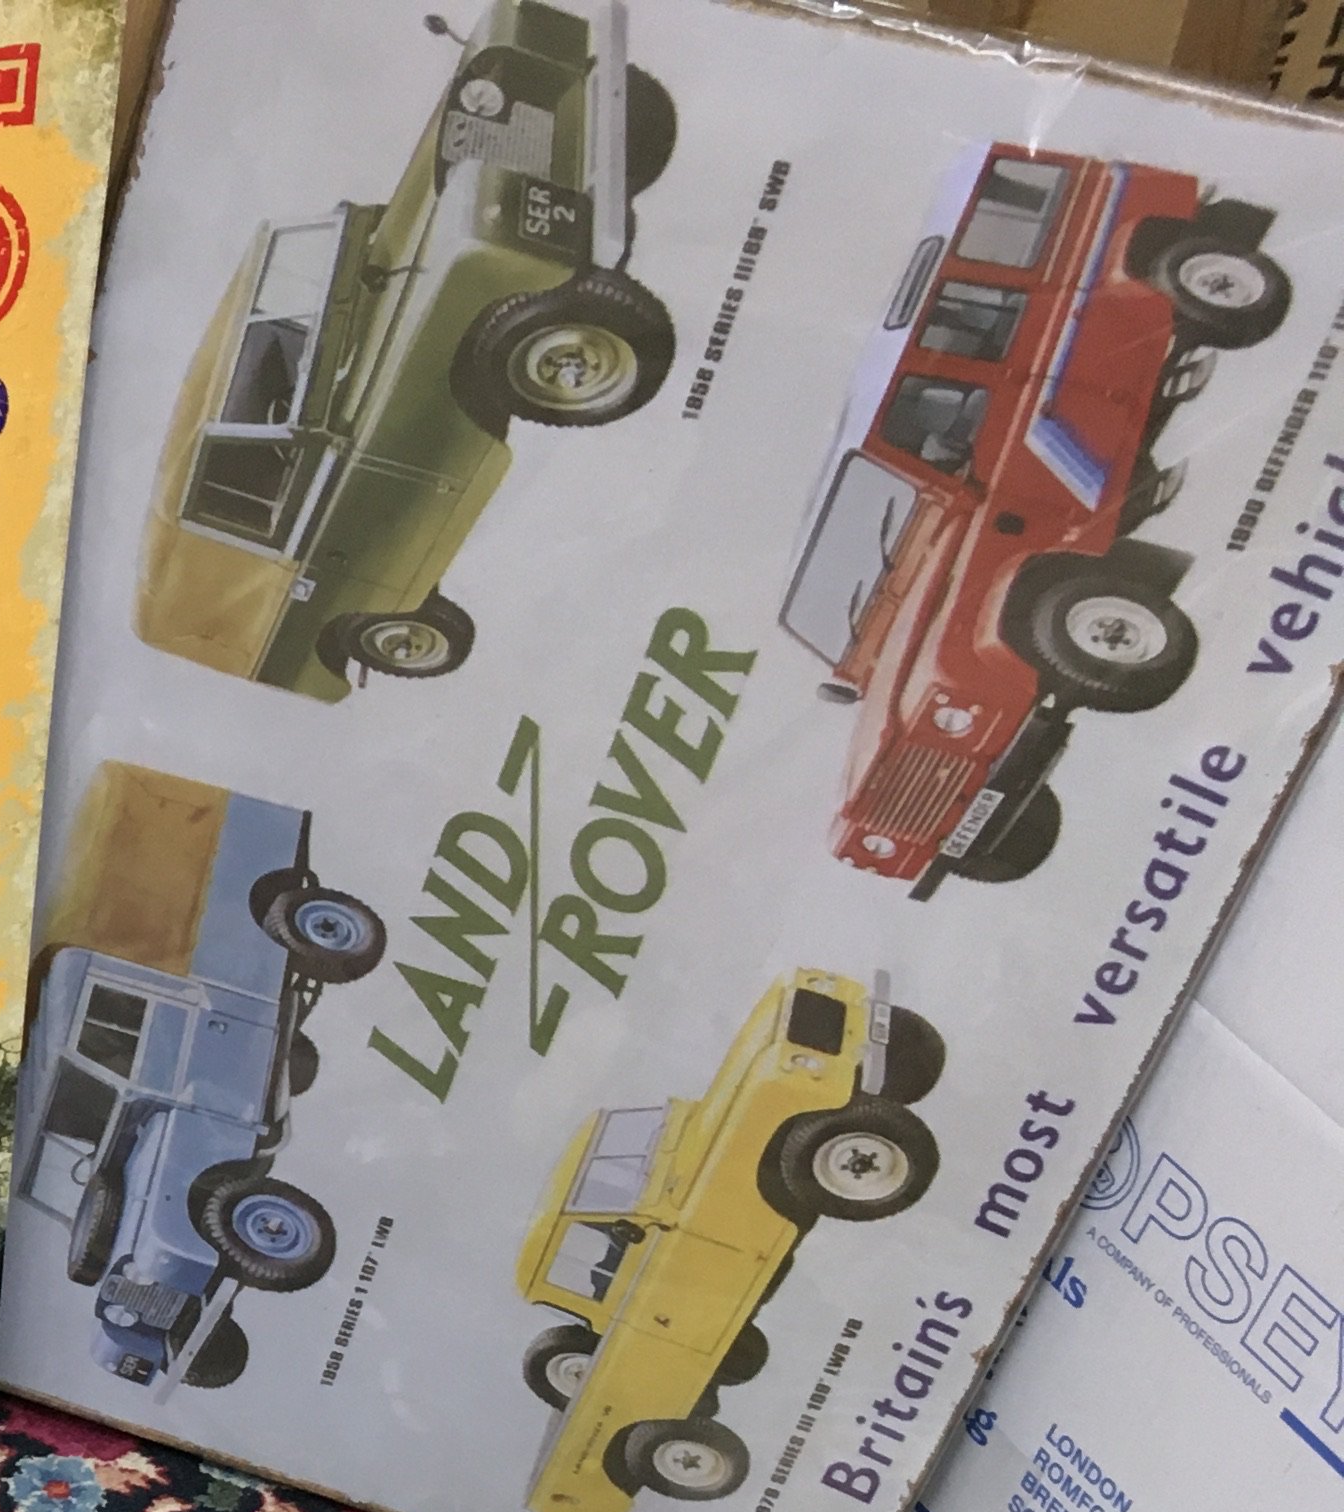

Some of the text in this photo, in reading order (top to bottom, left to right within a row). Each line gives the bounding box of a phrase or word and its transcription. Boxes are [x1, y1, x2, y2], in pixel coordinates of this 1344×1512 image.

[525, 186, 551, 236] SER
[553, 206, 575, 223] 2
[703, 286, 744, 364] SERIES
[367, 606, 759, 1105] LAND ROVER
[820, 1290, 974, 1505] Britain's
[974, 1088, 1078, 1241] most
[1072, 744, 1248, 1025] versatile
[334, 1297, 364, 1348] SERIES
[371, 1216, 395, 1249] LWB
[1086, 1226, 1098, 1242] A
[1096, 1233, 1157, 1294] COMPANY
[1154, 1288, 1175, 1308] OF
[1171, 1305, 1273, 1406] PROFESSIONALS
[822, 1342, 852, 1377] LWB
